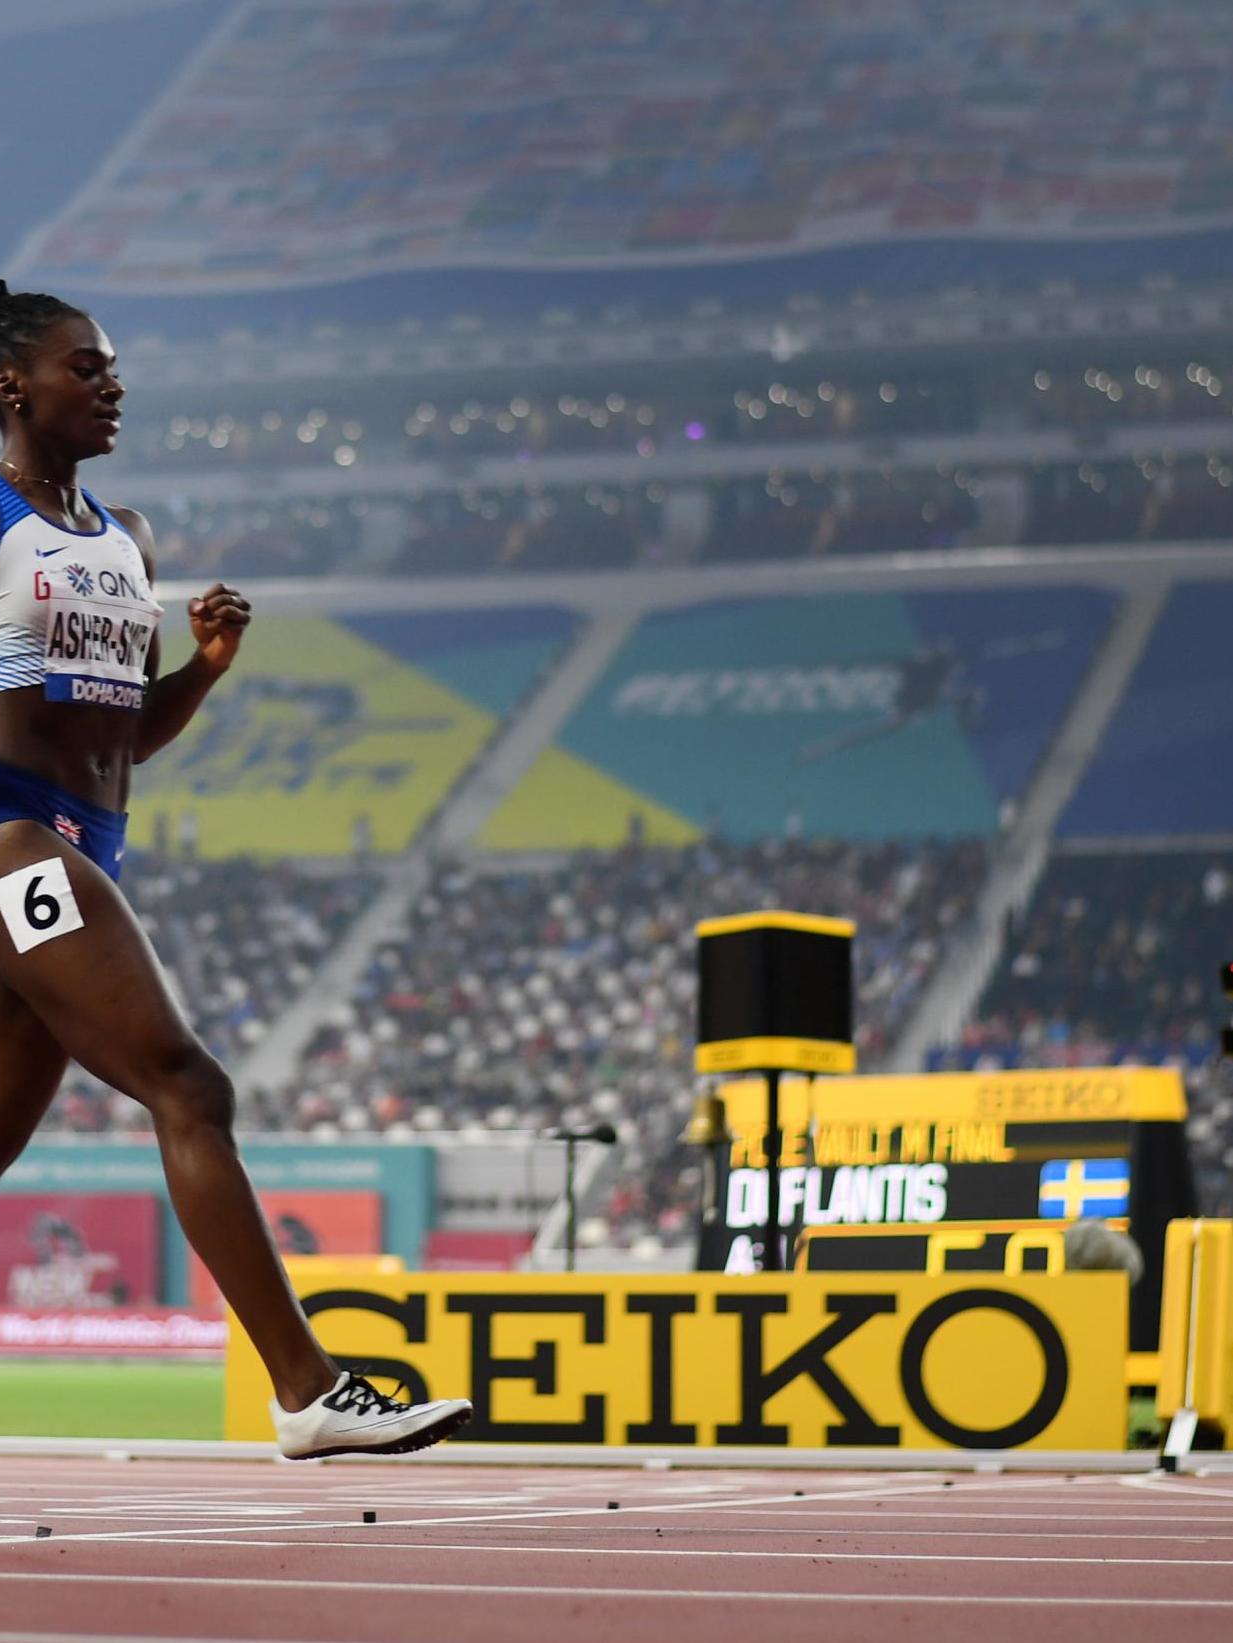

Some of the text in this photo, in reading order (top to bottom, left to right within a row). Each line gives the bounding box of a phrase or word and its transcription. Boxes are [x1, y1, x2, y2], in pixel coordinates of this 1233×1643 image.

[98, 570, 147, 602] QN
[24, 875, 61, 931] 6
[975, 1078, 1122, 1116] SEIKO
[298, 1288, 1070, 1450] SEIKO
